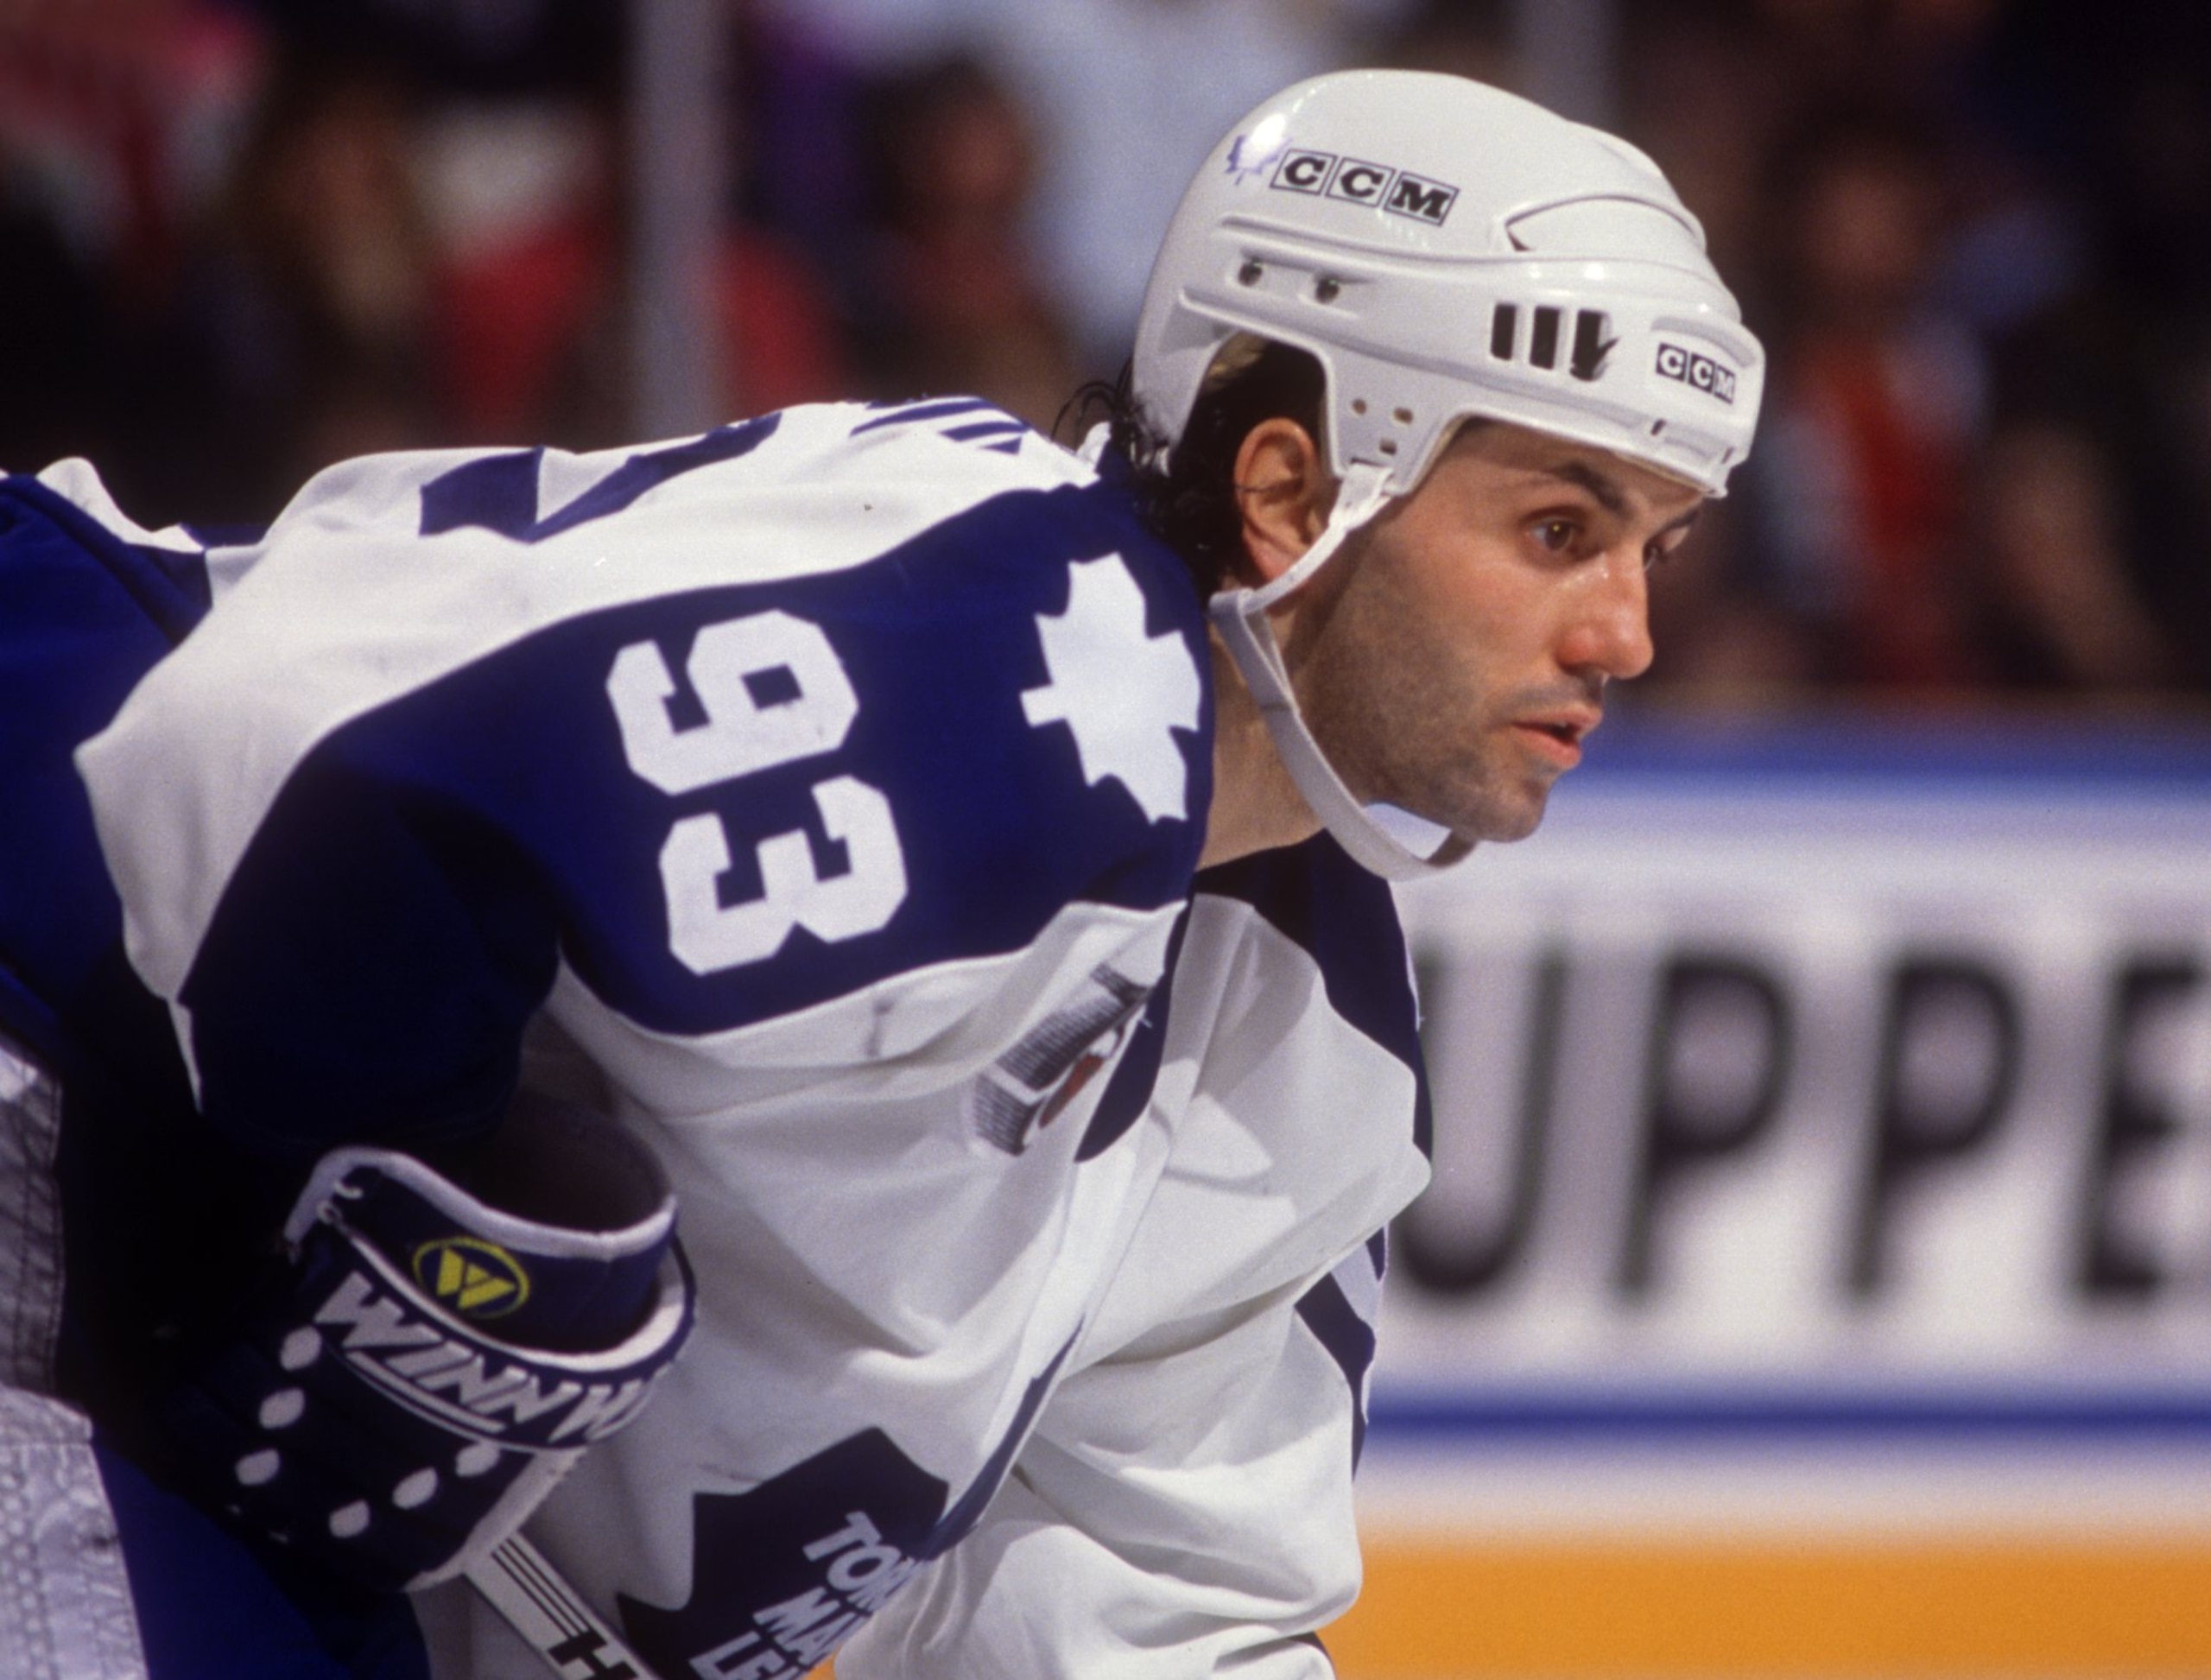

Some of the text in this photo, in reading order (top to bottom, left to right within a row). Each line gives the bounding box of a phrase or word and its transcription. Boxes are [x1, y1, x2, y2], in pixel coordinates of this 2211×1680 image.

[1280, 153, 1454, 225] CCM
[1658, 346, 1734, 401] CCM
[606, 610, 909, 976] 93
